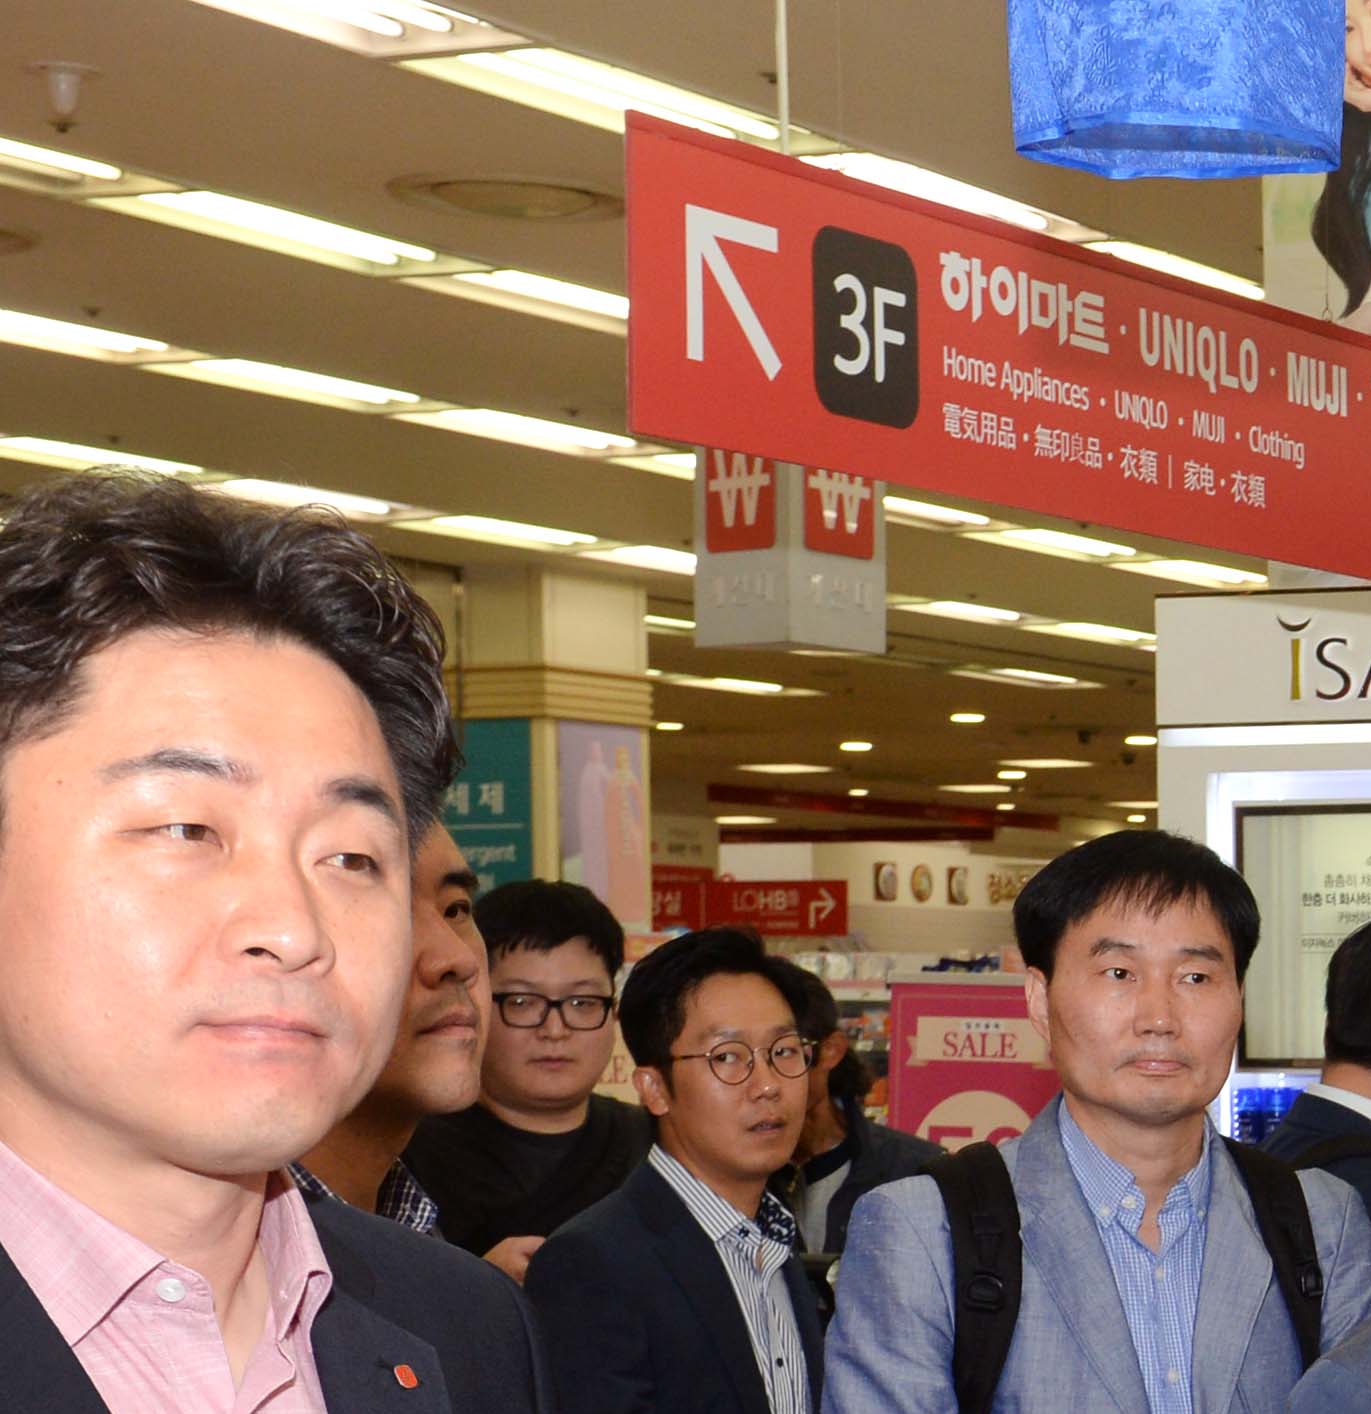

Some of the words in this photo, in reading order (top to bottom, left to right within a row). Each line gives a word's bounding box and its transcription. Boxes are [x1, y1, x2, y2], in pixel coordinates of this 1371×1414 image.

[832, 273, 907, 384] 3F
[939, 250, 1110, 355] 하이마트
[1139, 307, 1259, 394] UNIQLO
[1286, 351, 1348, 417] MUJI
[943, 345, 997, 389] Home
[1000, 361, 1090, 412] Appliances
[1114, 390, 1168, 430] UNIQLO
[1192, 409, 1225, 444] MUJI
[1249, 425, 1306, 469] Clothing
[942, 1031, 1018, 1059] SALE
